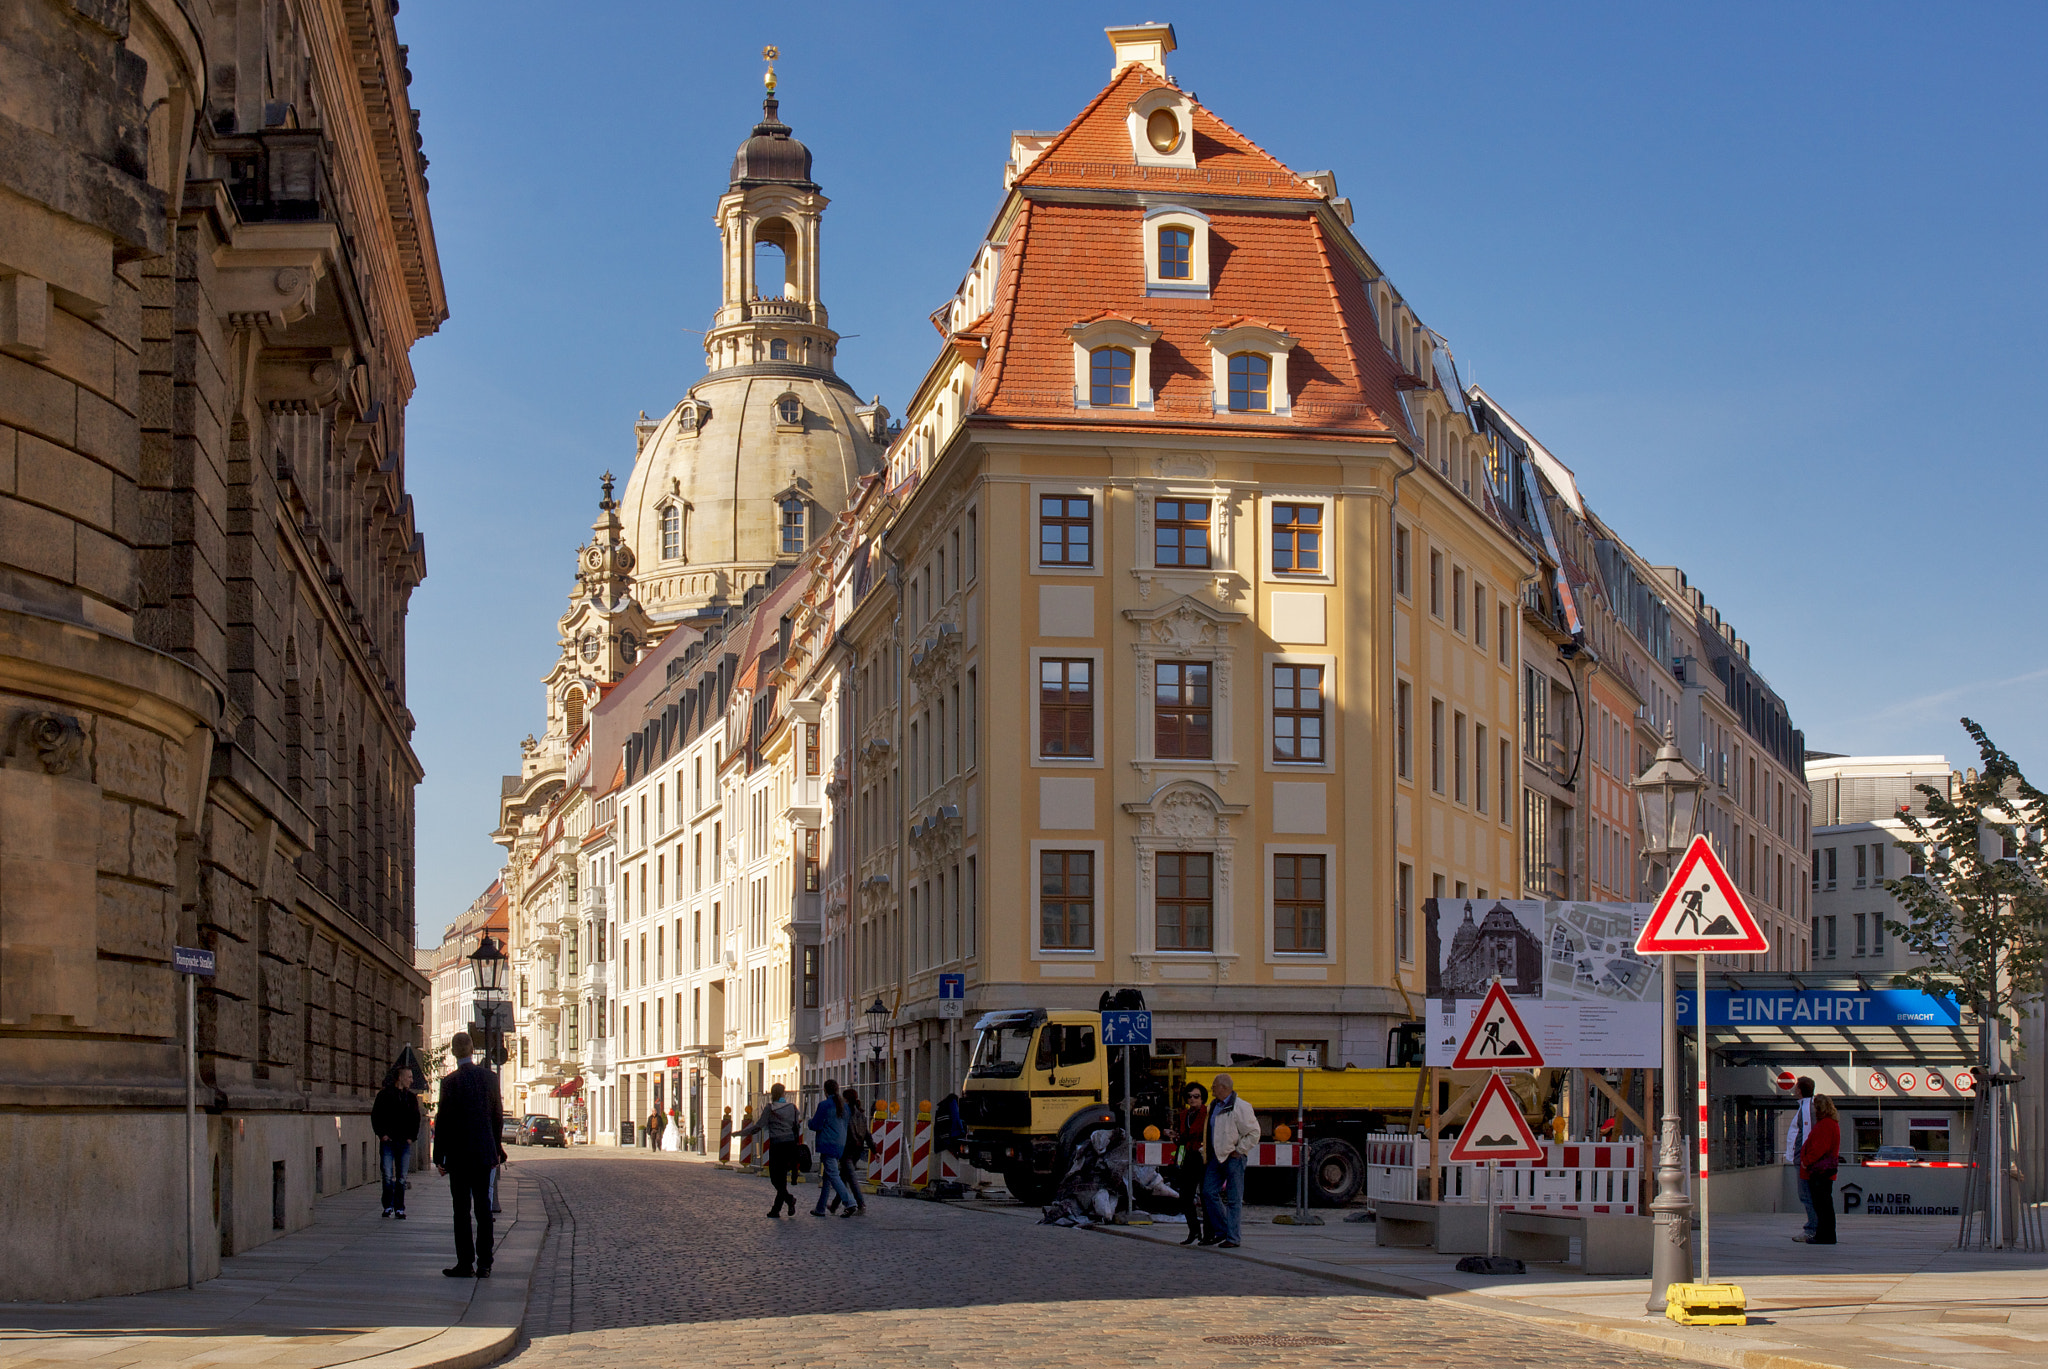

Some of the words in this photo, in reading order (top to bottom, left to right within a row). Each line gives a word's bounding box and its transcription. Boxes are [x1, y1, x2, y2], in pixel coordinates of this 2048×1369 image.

[1728, 998, 1871, 1021] EINFAHRT
[1897, 1013, 1934, 1021] BEWACHT
[1844, 1193, 1861, 1214] P
[1867, 1193, 1883, 1203] AN
[1887, 1193, 1911, 1204] DER
[1867, 1205, 1959, 1215] FRAUENKIRCHE
